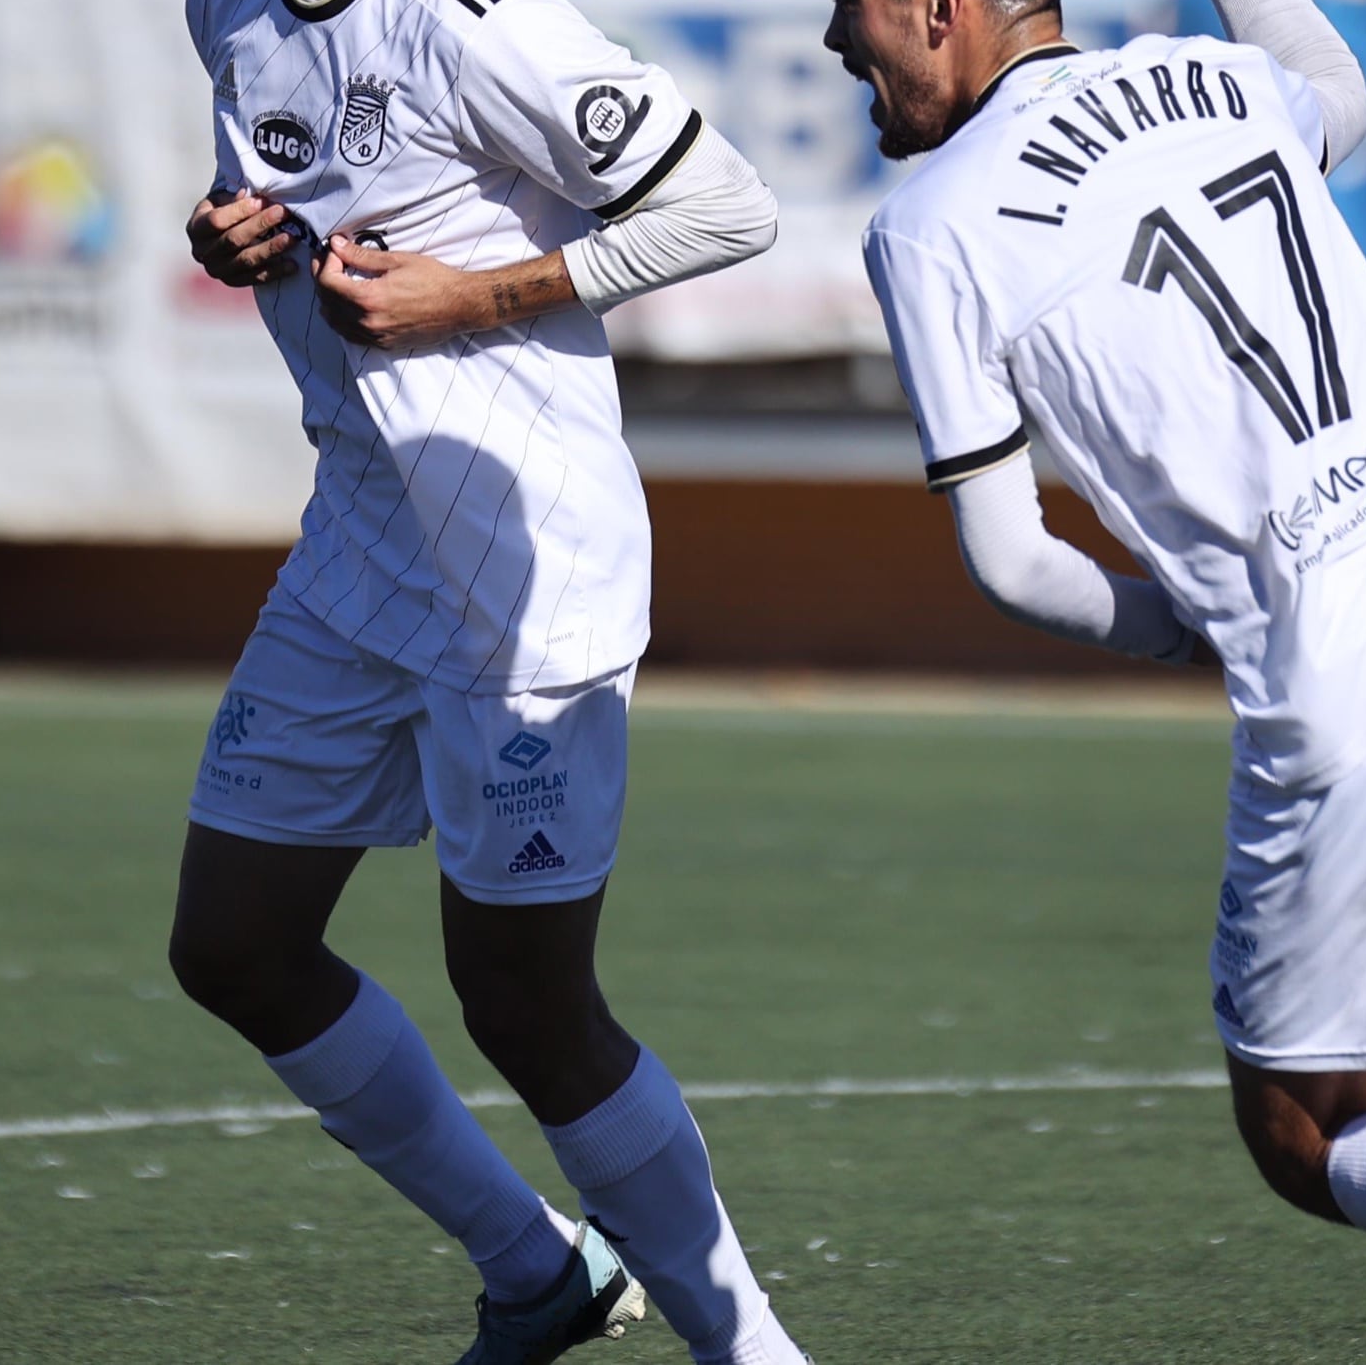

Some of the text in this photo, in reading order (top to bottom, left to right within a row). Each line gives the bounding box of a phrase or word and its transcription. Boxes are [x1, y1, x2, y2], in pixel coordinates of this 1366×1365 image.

[600, 112, 622, 137] LIM
[1018, 60, 1248, 186] NAVARRO
[256, 128, 314, 164] LUGO
[1121, 149, 1352, 446] 17
[483, 770, 569, 800] OCIOPLAY
[496, 793, 565, 817] INDOOR
[509, 811, 557, 828] JEREZ
[509, 854, 566, 874] adidas
